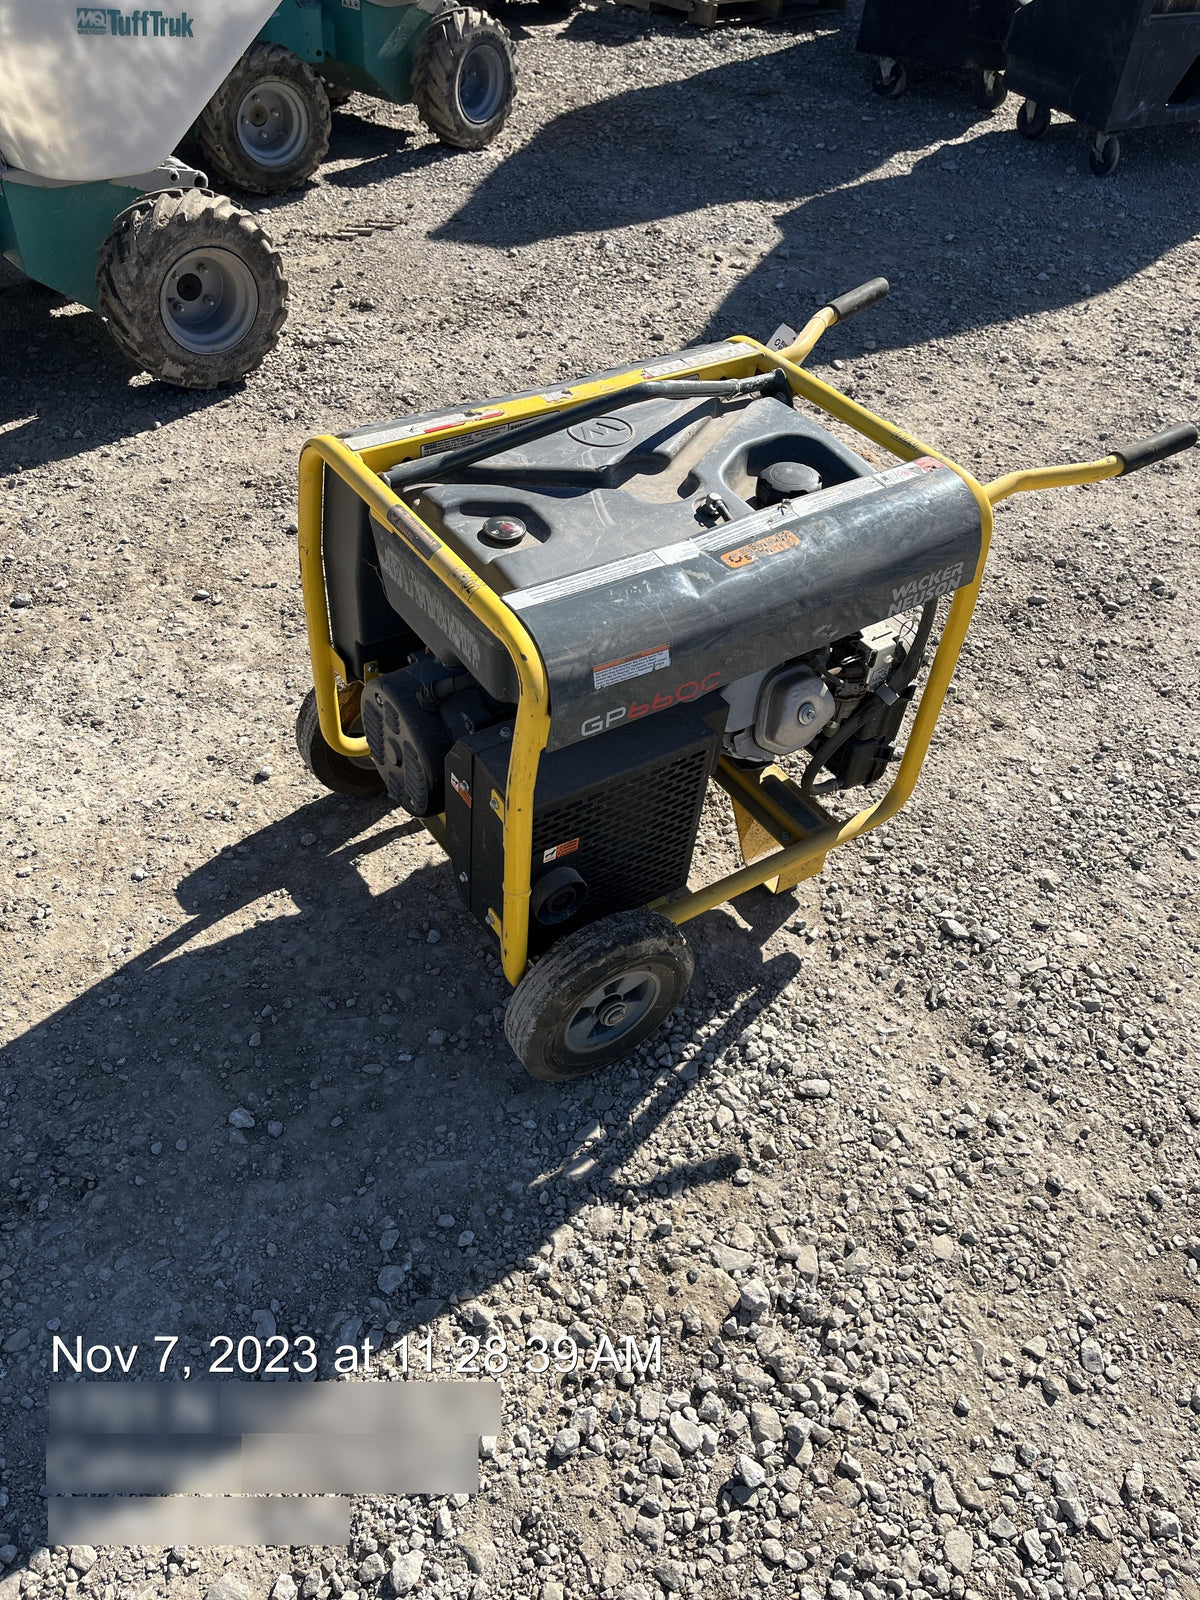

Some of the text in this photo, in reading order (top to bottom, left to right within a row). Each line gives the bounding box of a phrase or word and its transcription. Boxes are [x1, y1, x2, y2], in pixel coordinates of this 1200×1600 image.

[107, 8, 194, 37] TuffTruk
[888, 575, 961, 616] NEUSON
[892, 561, 964, 600] WACKER
[581, 671, 721, 737] GP660C
